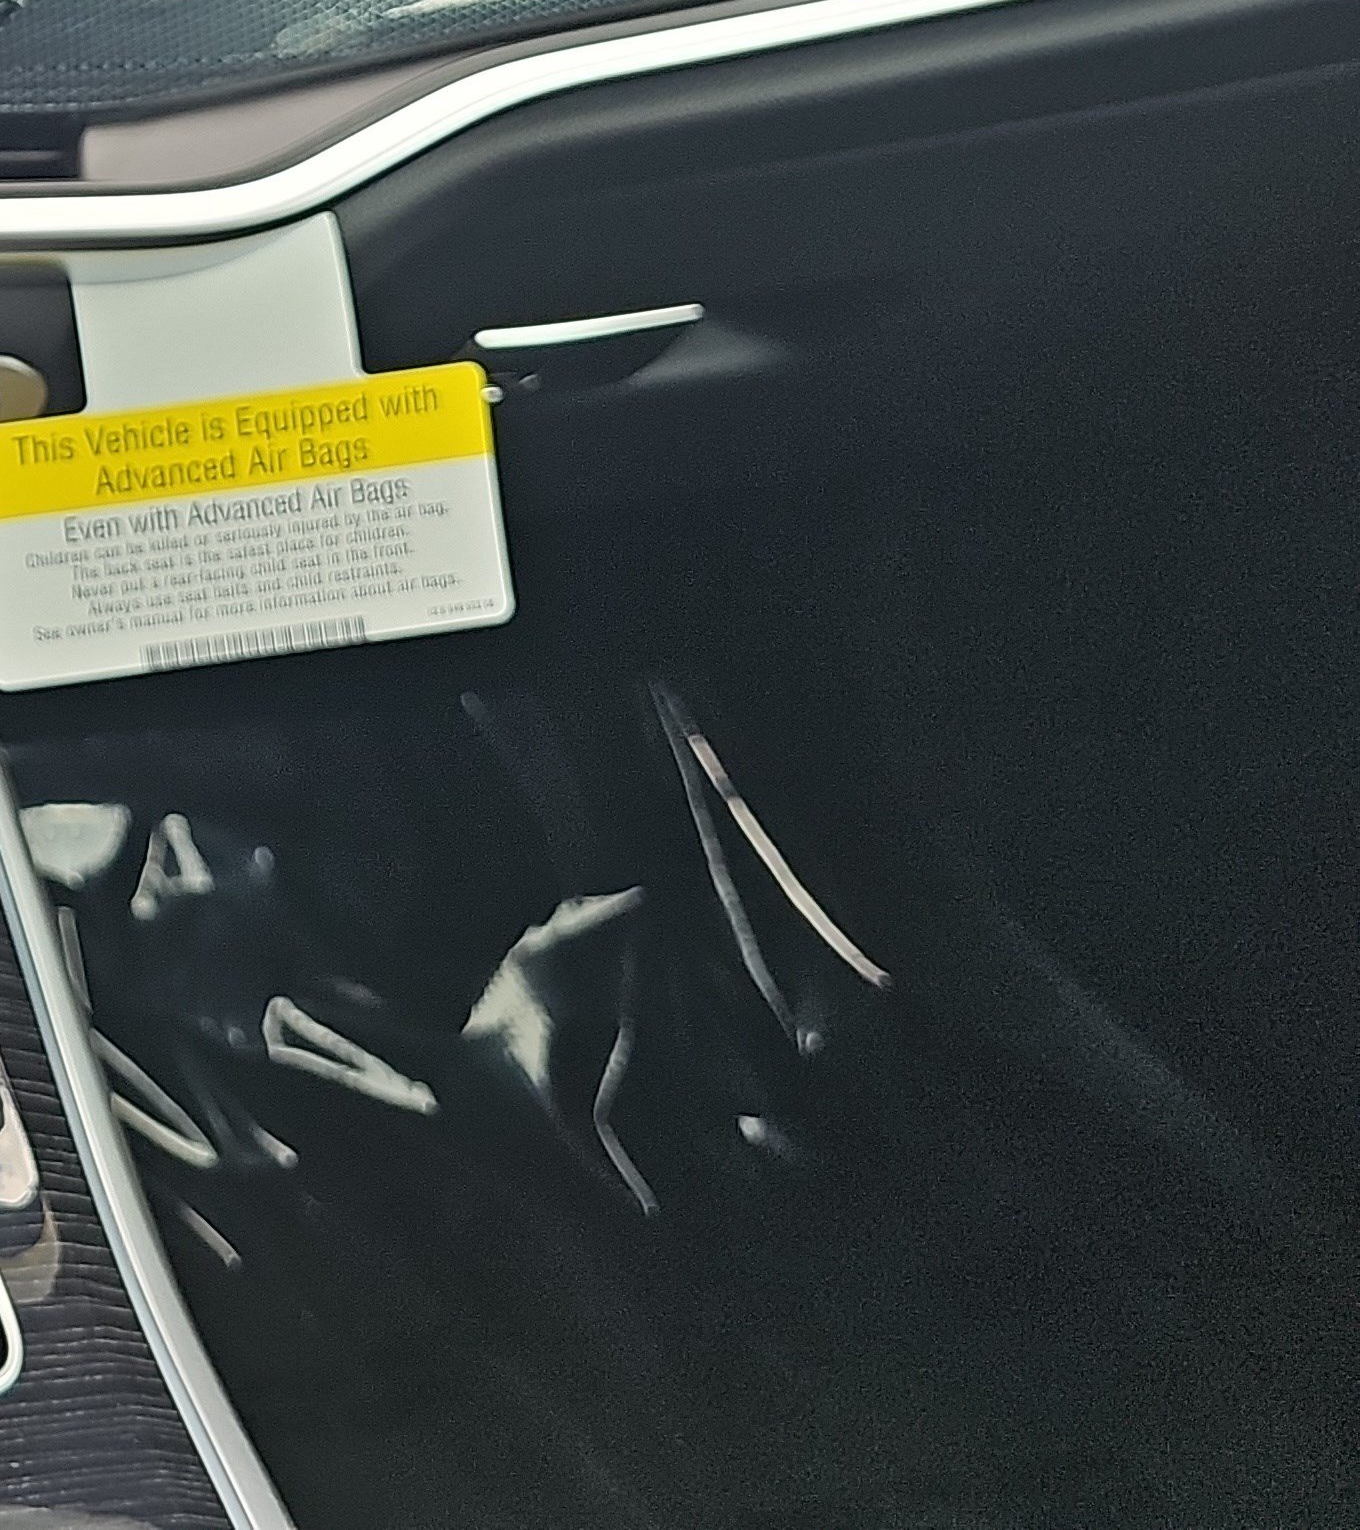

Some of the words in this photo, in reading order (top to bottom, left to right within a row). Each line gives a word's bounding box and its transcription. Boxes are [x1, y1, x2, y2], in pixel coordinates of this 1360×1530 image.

[13, 432, 76, 466] This
[84, 417, 189, 456] Vehicle
[201, 412, 224, 442] is
[235, 393, 369, 440] Equipped
[380, 386, 438, 418] with
[95, 452, 236, 495] Advanced
[248, 444, 287, 476] Air
[299, 436, 368, 469] Bags
[26, 549, 89, 570] Children
[94, 545, 120, 561] can
[149, 533, 188, 554] killed
[217, 521, 280, 544] seriously
[288, 512, 338, 536] injured
[366, 506, 390, 524] the
[394, 503, 412, 520] air
[418, 500, 449, 518] bag.
[63, 516, 120, 544] Even
[129, 504, 178, 536] with
[187, 490, 302, 527] Advanced
[309, 483, 343, 511] Air
[349, 476, 412, 506] Bags
[71, 583, 114, 601] Never
[120, 576, 143, 598] put
[163, 564, 243, 588] rear-facing
[250, 556, 286, 576] child
[294, 551, 321, 570] seat
[345, 545, 369, 563] the
[374, 538, 414, 559] front.
[72, 564, 98, 582] The
[104, 558, 137, 578] back
[143, 552, 174, 572] seat
[198, 547, 221, 565] the
[228, 539, 270, 560] safest
[276, 536, 314, 557] place
[320, 531, 338, 548] for
[346, 524, 410, 544] children.
[34, 626, 60, 643] See
[66, 616, 124, 638] owner's
[130, 607, 182, 629] manual
[189, 605, 208, 621] for
[215, 600, 254, 617] more
[259, 586, 345, 611] information
[352, 577, 392, 598] about
[398, 575, 417, 592] air
[422, 572, 461, 590] bags.
[88, 598, 140, 618] Always
[146, 594, 172, 609] use
[178, 585, 207, 605] seat
[214, 580, 248, 600] belts
[257, 575, 280, 594] and
[286, 569, 322, 590] child
[328, 560, 402, 584] restraints.
